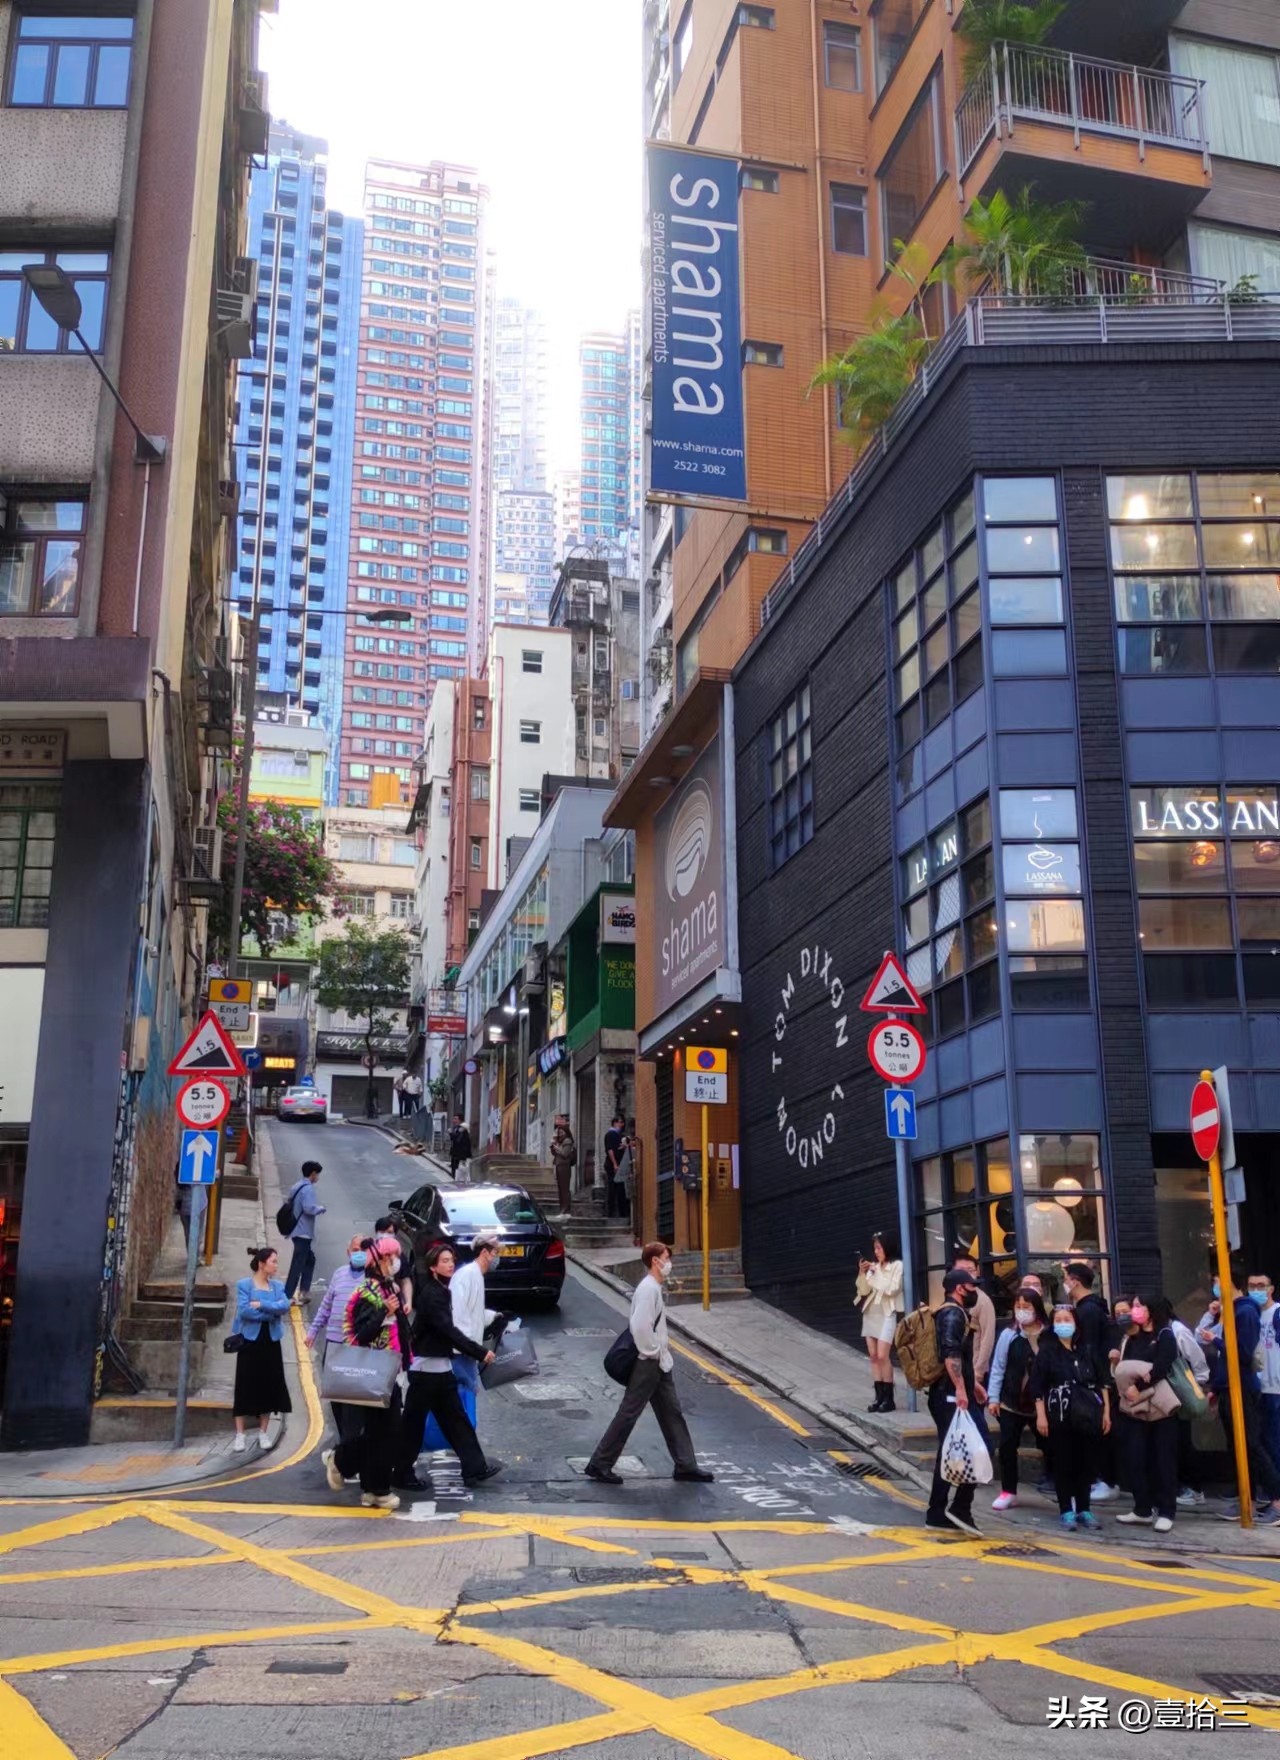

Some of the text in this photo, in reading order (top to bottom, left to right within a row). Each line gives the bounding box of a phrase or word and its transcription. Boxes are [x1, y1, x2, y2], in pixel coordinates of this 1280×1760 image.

[653, 212, 670, 364] serviced apartments
[669, 172, 737, 416] shama
[652, 439, 743, 458] www.shama.com
[673, 460, 727, 476] 2522 3082
[21, 735, 58, 745] ROAD
[1026, 871, 1063, 881] LASSANA
[662, 890, 717, 976] shama
[608, 969, 628, 979] GIVE
[883, 979, 901, 994] 1:5
[220, 1005, 239, 1014] End
[883, 1031, 910, 1048] 5.5
[195, 1039, 216, 1056] 1:5
[885, 1050, 910, 1060] tonnes
[772, 945, 849, 1168] TOM DIXON LONDON
[697, 1075, 716, 1085] End
[191, 1087, 216, 1100] 5.5
[694, 1087, 720, 1100] 終止
[728, 1486, 816, 1516] LOOK
